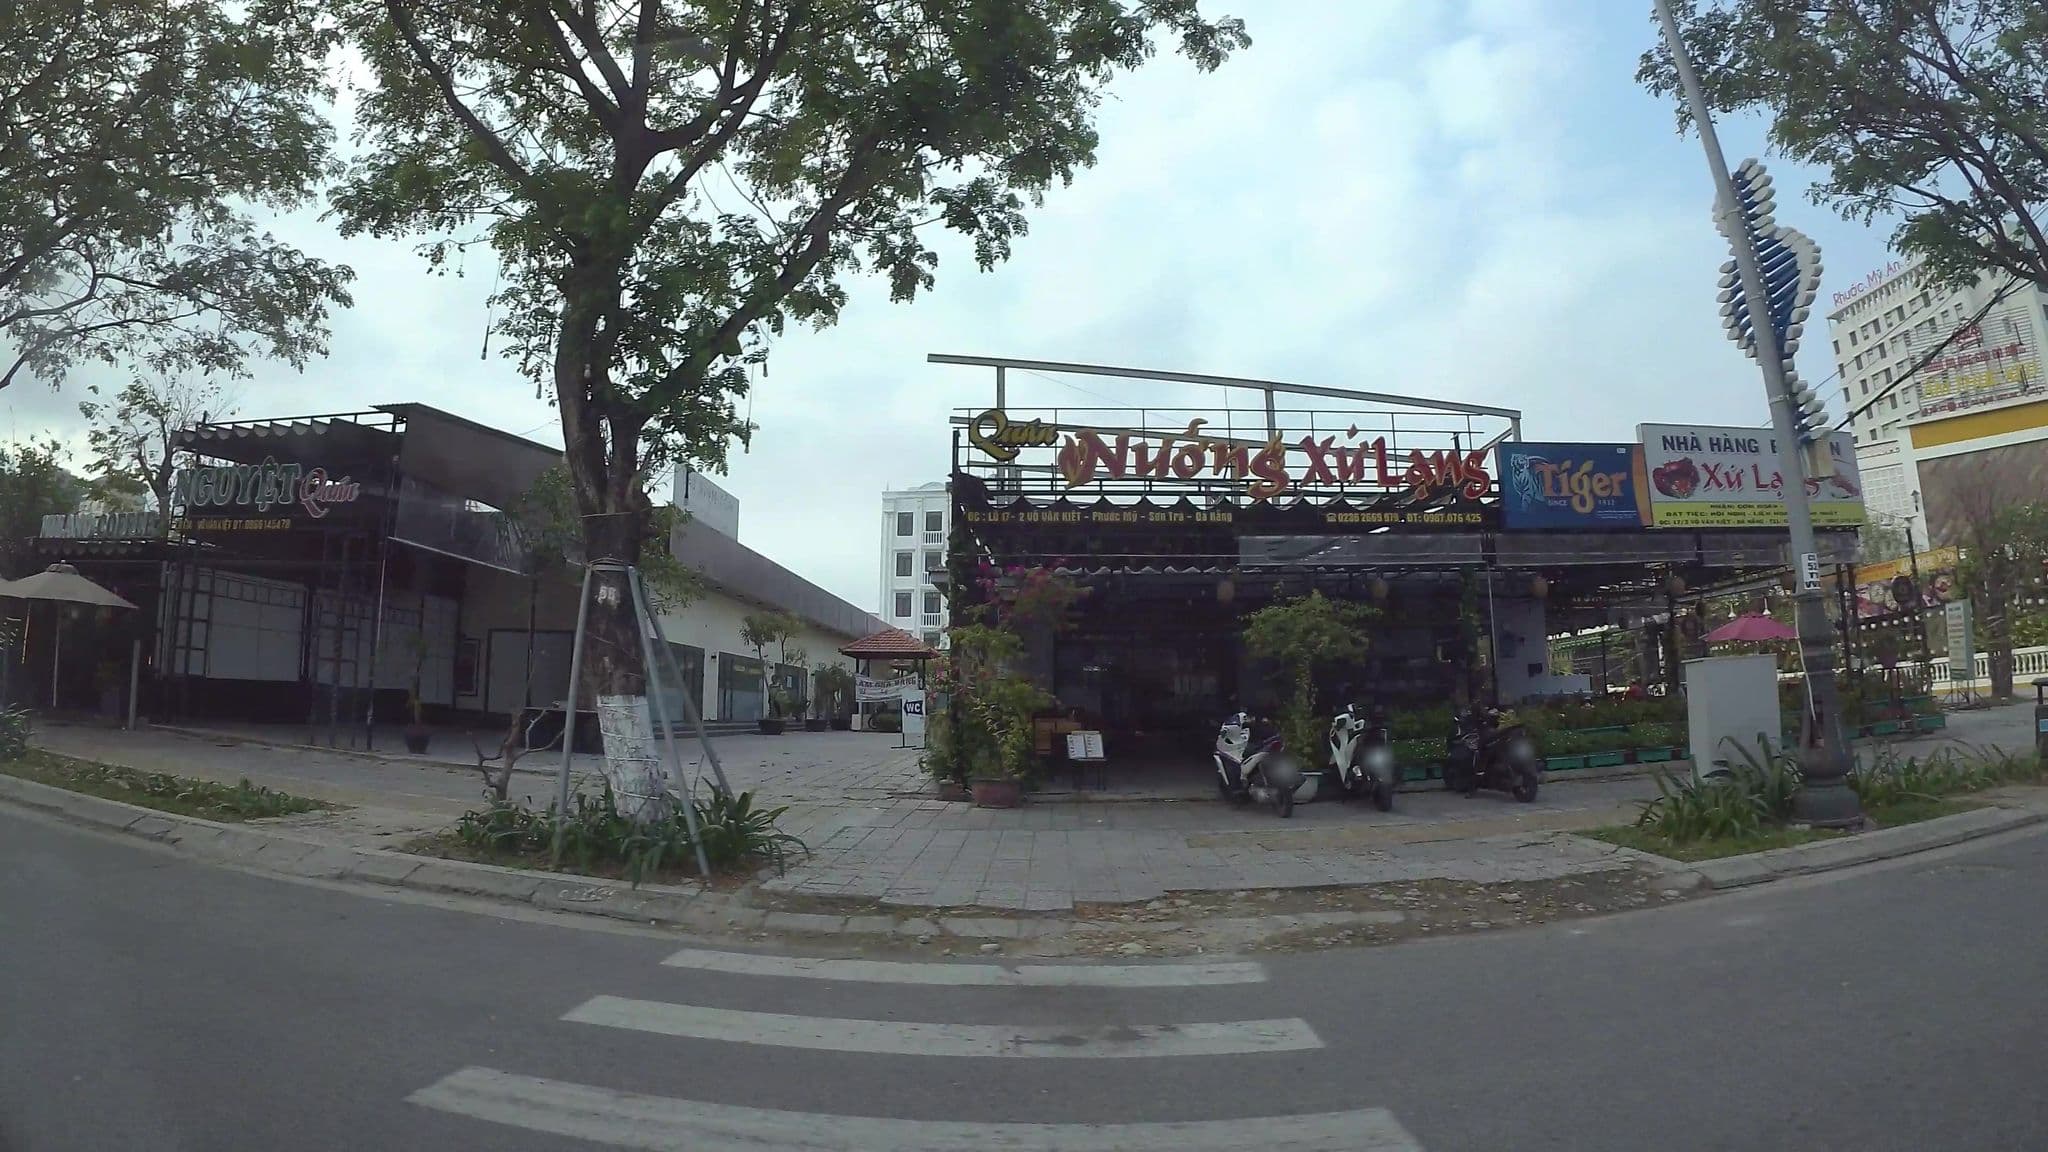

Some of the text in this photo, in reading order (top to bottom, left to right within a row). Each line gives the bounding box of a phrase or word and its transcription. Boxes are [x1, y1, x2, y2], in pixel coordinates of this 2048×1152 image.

[1886, 261, 1901, 277] An
[968, 408, 1059, 462] Quán
[1661, 432, 1702, 453] NHÀ
[1709, 433, 1759, 454] HÀNG
[1058, 418, 1494, 500] Nướng Xứ Lạng
[1701, 462, 1745, 492] Xứ
[174, 455, 301, 513] NGUYỆT
[1534, 459, 1627, 513] Tiger
[906, 703, 921, 713] WC
